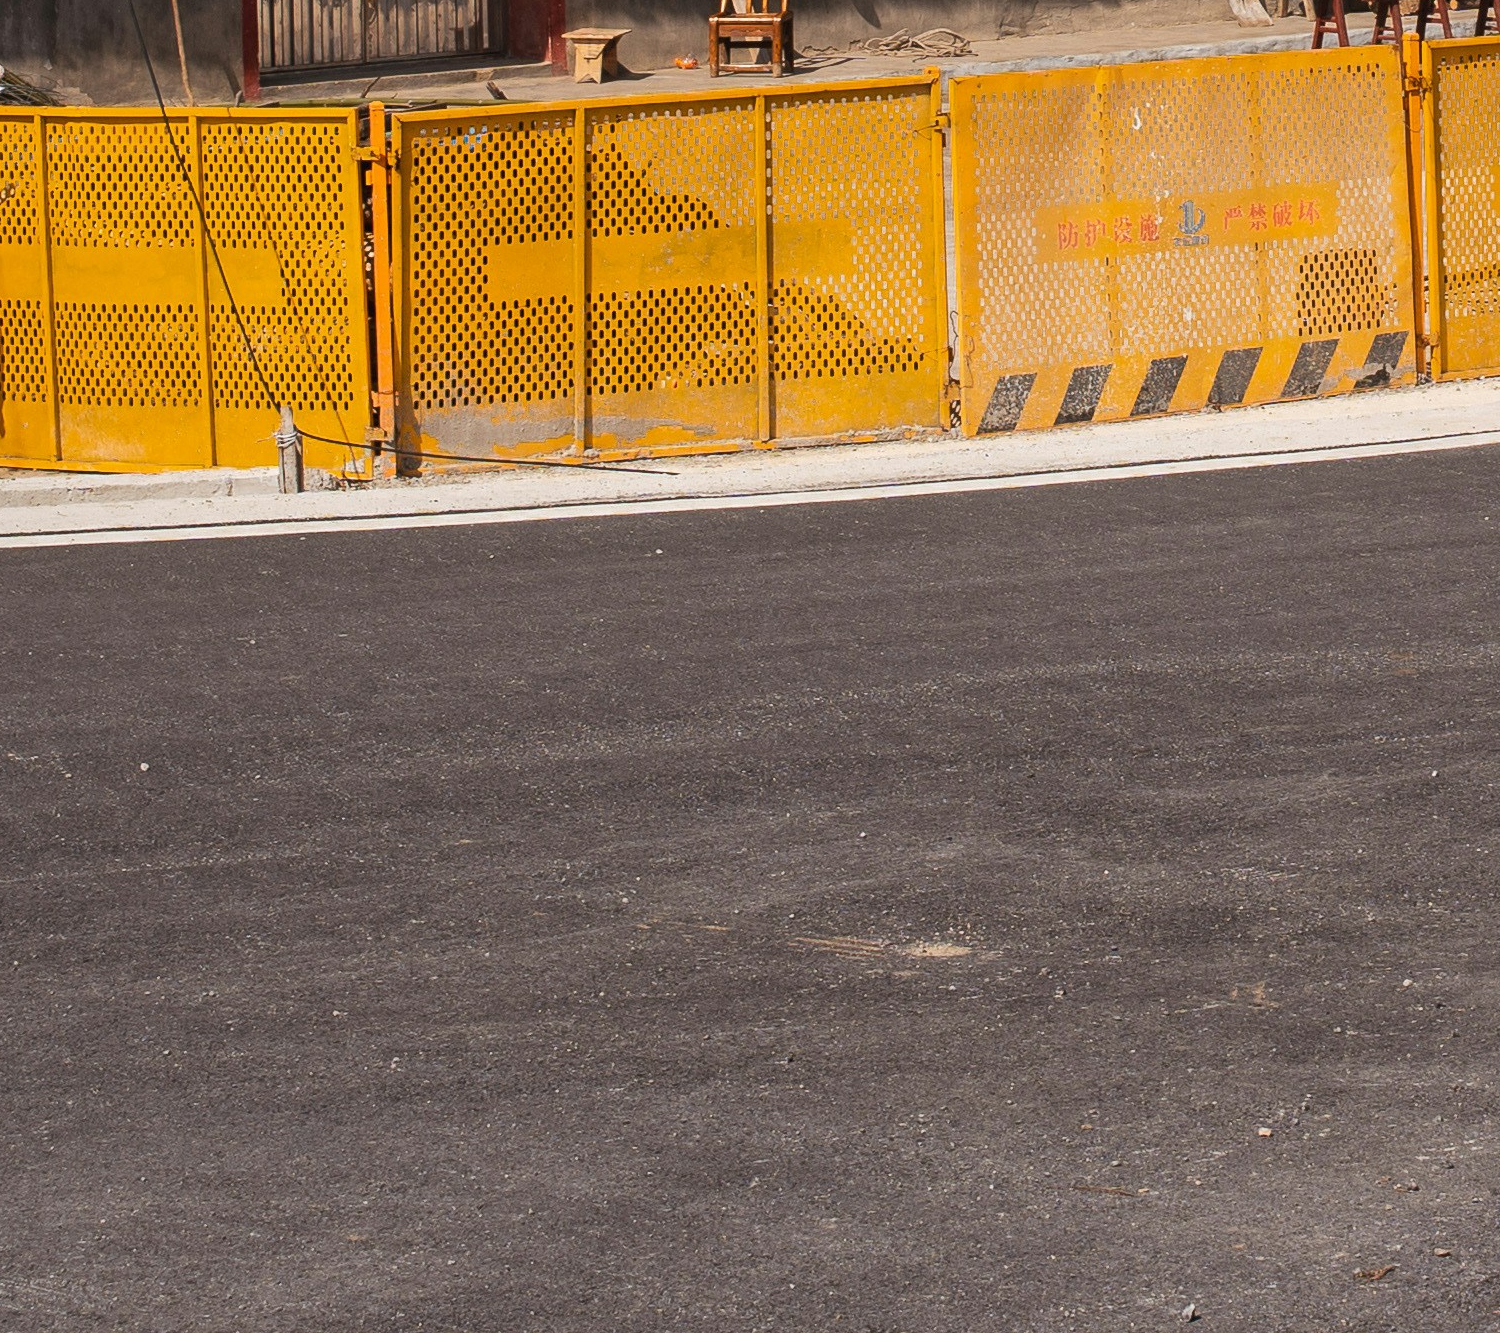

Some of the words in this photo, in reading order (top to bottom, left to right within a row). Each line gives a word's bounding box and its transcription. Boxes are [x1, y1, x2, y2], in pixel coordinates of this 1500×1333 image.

[1057, 214, 1160, 250] 防护设施
[1223, 200, 1321, 231] 严禁破坏
